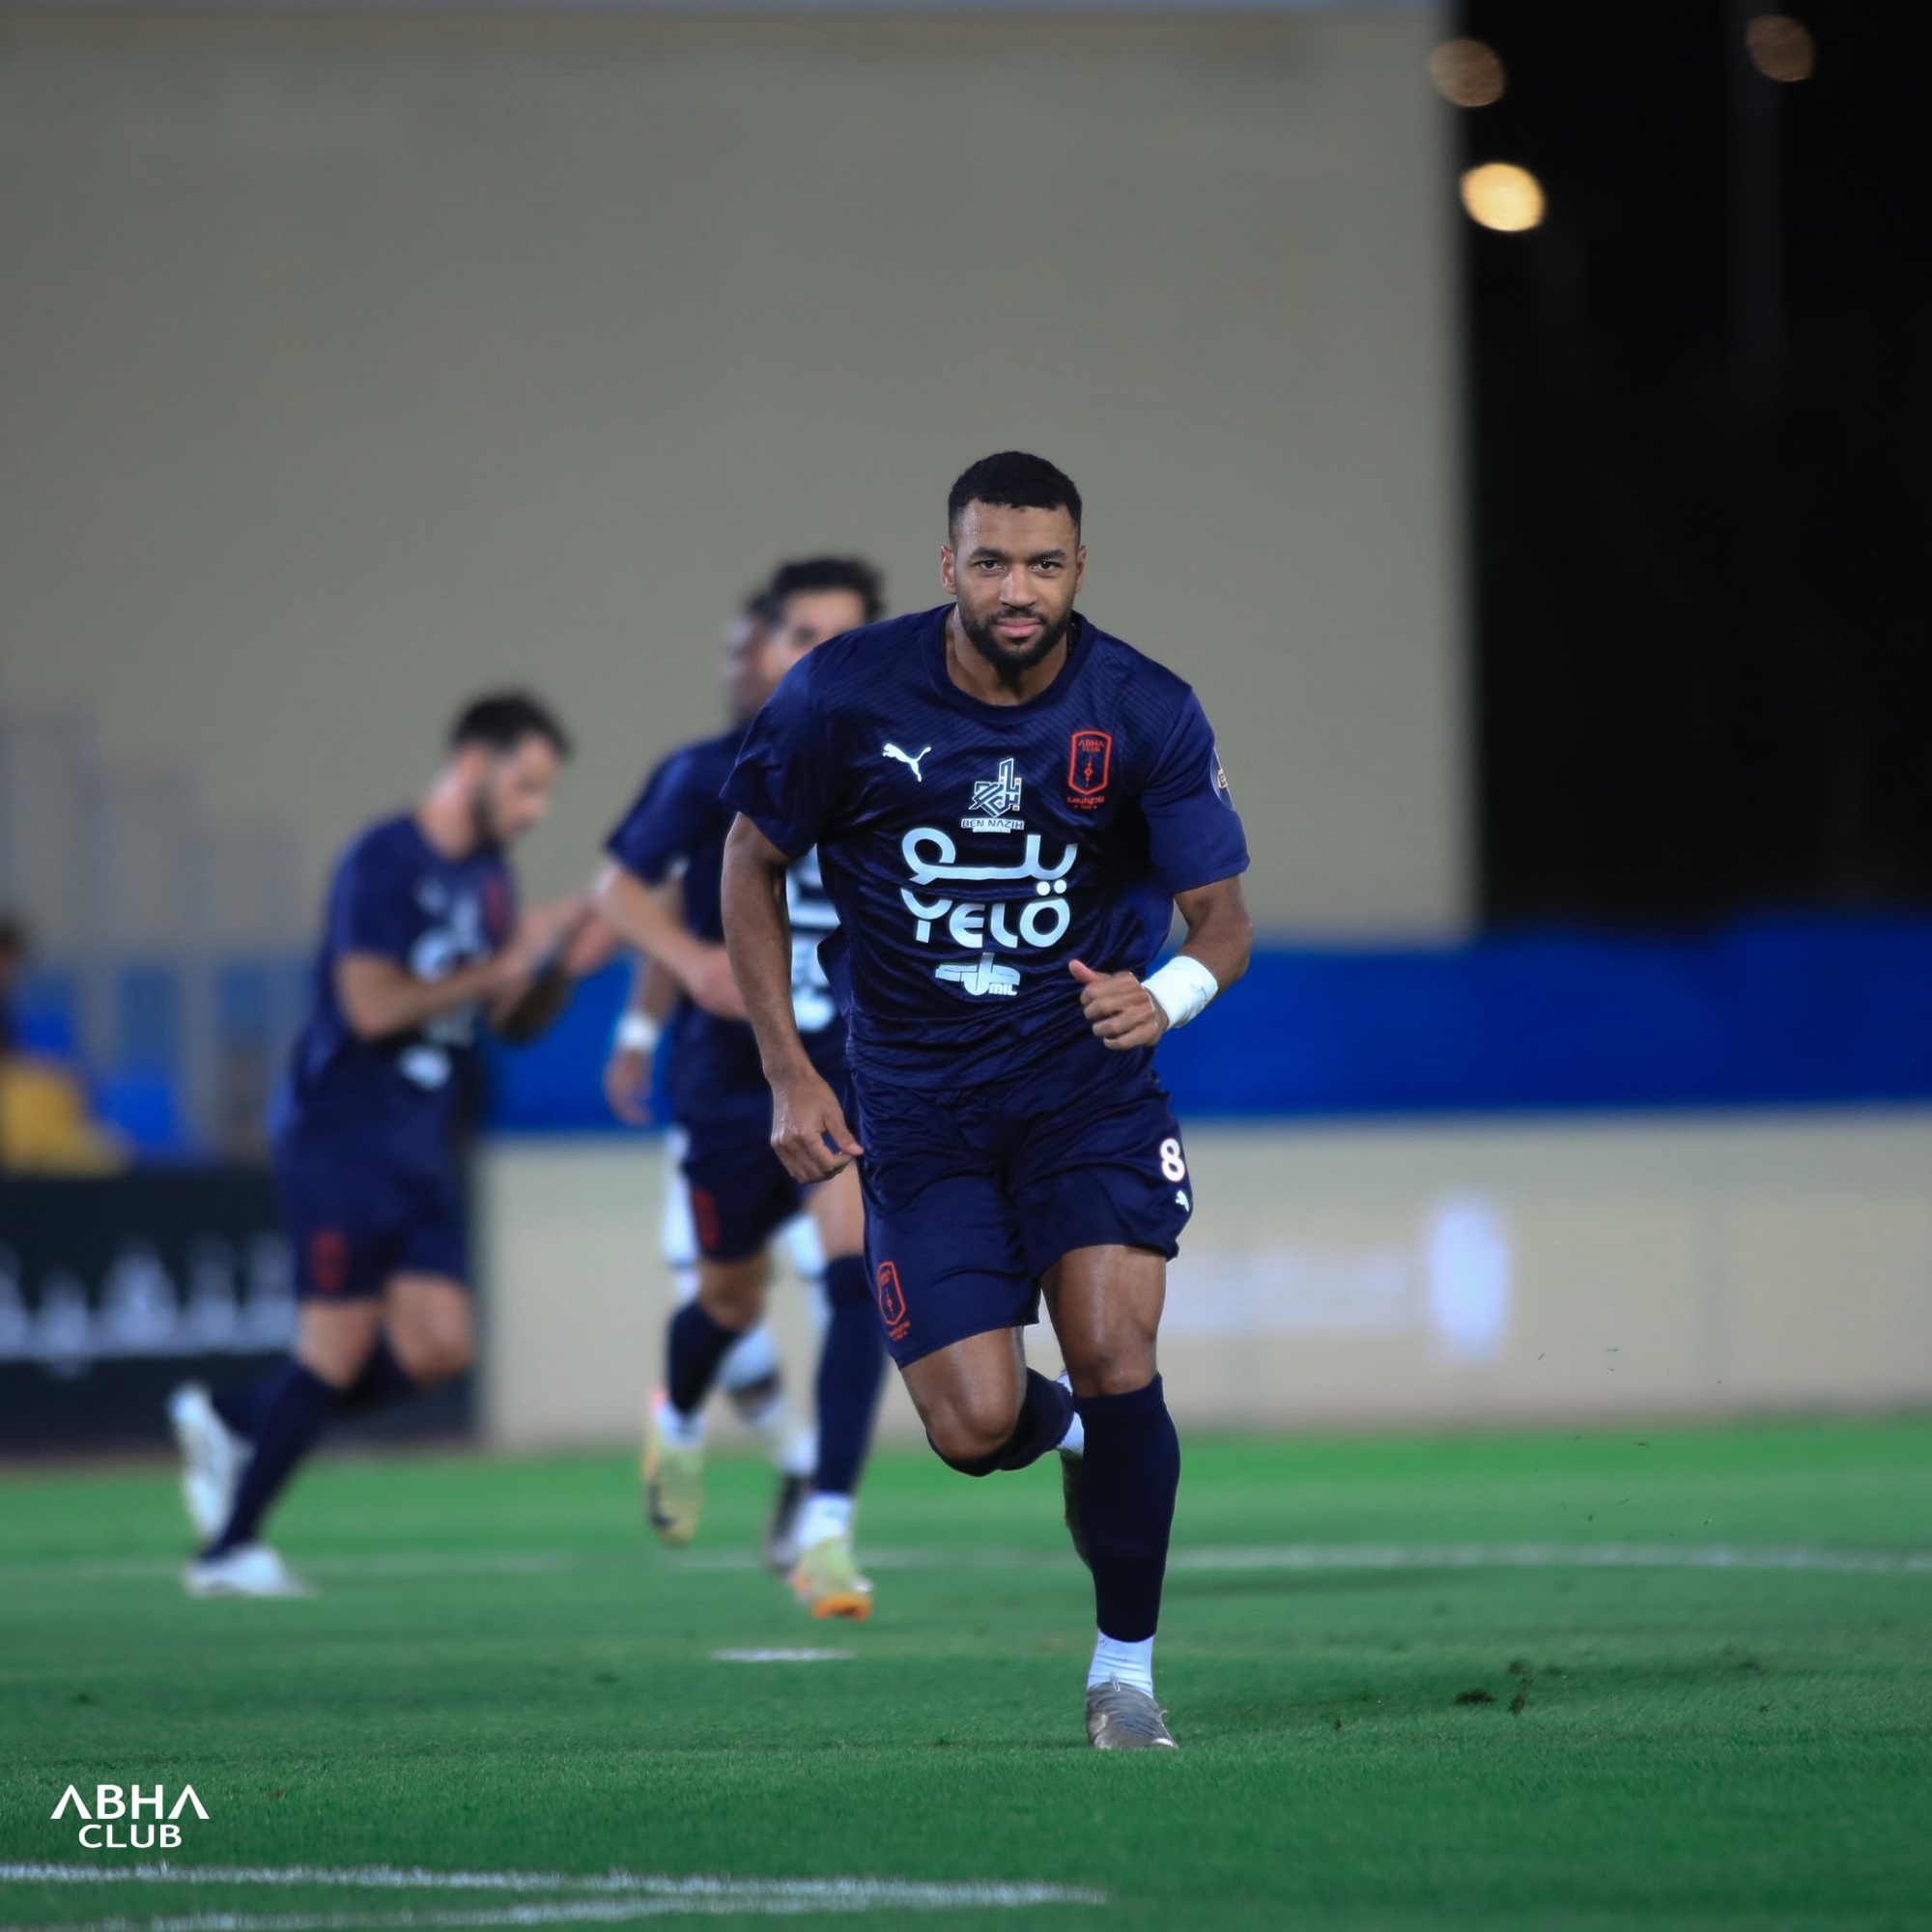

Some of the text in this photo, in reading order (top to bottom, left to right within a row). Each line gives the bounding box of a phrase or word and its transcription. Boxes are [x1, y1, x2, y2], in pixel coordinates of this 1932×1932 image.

[963, 819, 984, 828] BEN
[987, 819, 1024, 830] NAZIH
[988, 983, 1018, 996] MIL
[1160, 1138, 1185, 1181] 8
